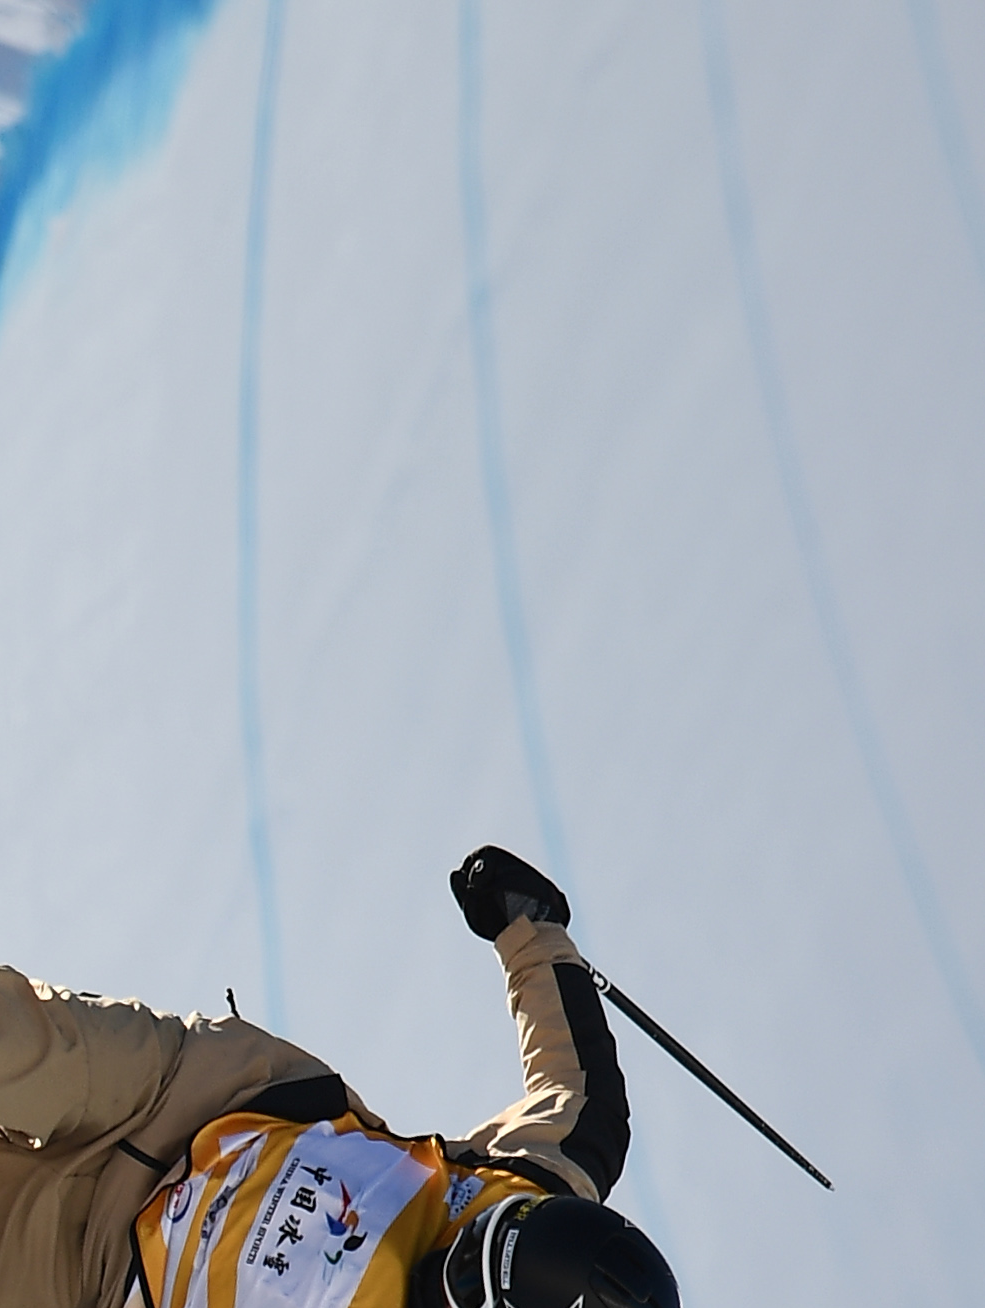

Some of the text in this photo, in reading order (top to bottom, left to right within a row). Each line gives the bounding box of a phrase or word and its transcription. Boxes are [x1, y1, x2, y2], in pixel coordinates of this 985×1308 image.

[246, 1158, 301, 1264] CHINA WINTER SPORTS
[262, 1165, 332, 1276] 中国冰雪
